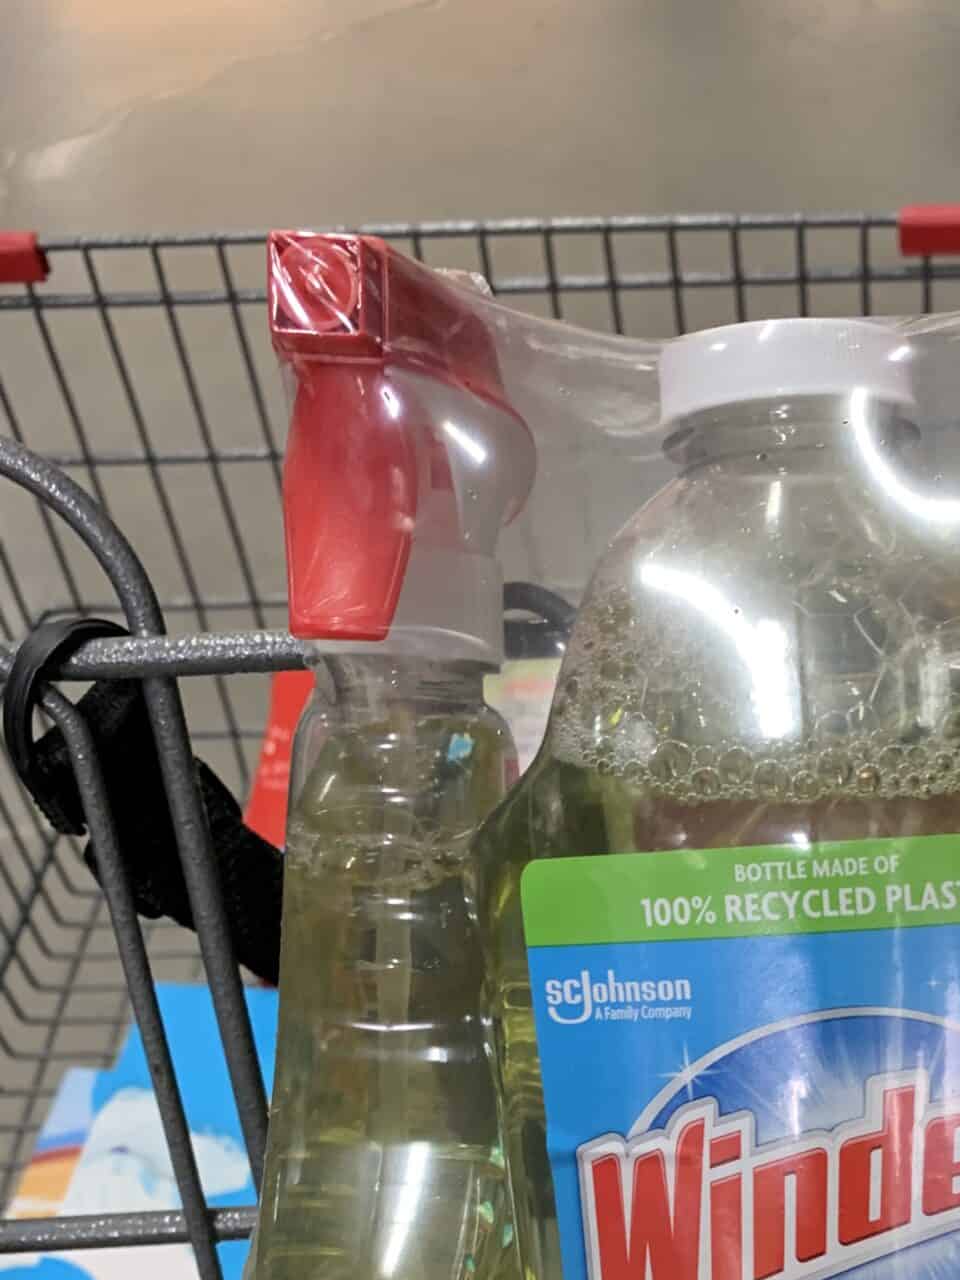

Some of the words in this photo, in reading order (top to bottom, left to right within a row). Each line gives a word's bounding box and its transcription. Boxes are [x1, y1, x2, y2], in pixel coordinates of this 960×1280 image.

[734, 859, 806, 883] BOTTLE
[812, 856, 868, 878] MADE
[873, 854, 899, 874] OF
[640, 895, 716, 928] 100%
[724, 886, 876, 923] RECYCLED
[594, 1008, 603, 1021] A
[604, 1005, 639, 1022] Family
[640, 1004, 692, 1021] Company
